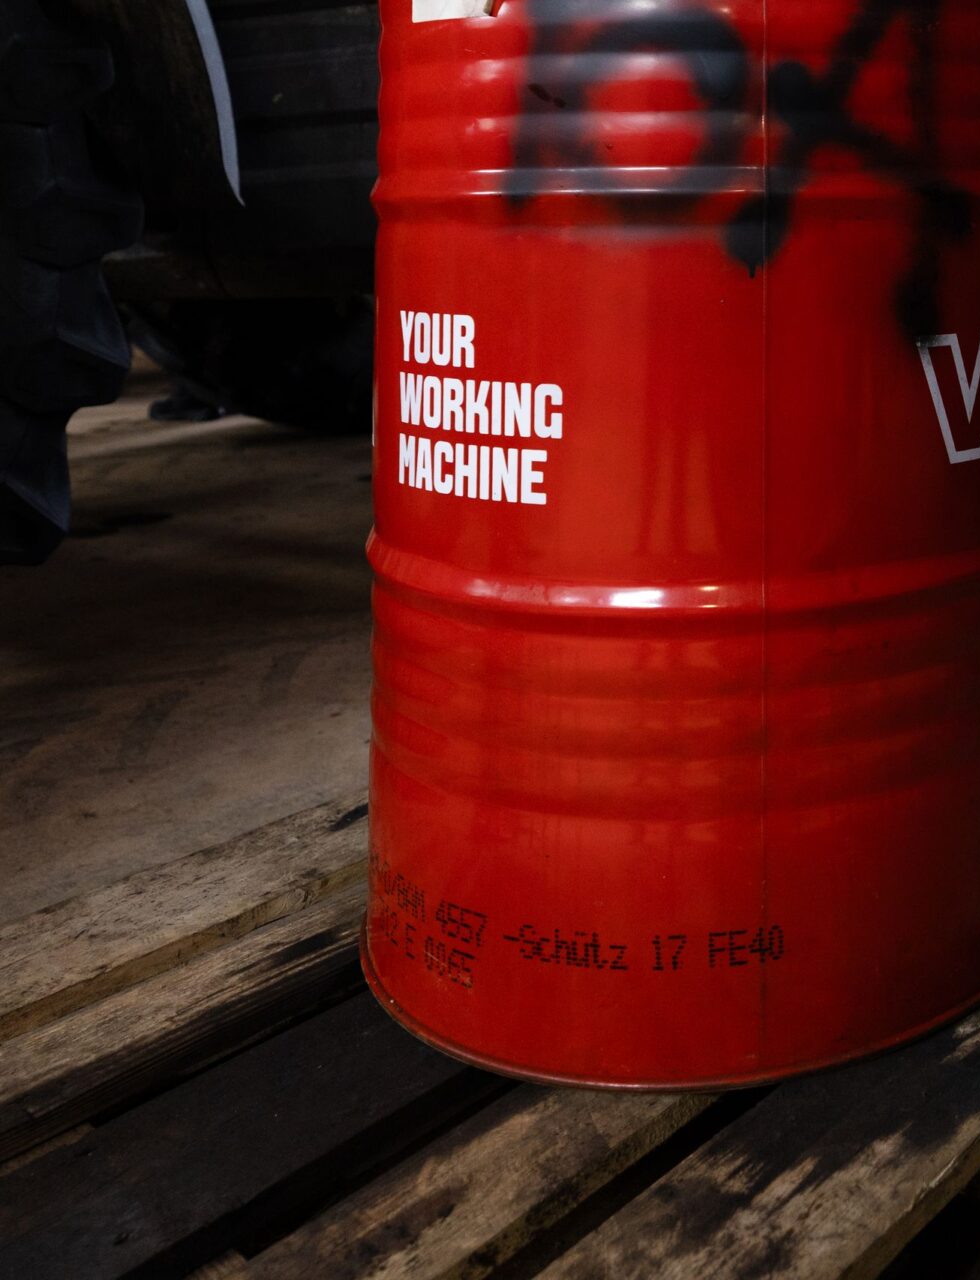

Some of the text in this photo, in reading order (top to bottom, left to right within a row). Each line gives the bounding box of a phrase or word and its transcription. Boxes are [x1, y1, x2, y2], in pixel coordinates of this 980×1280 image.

[400, 310, 475, 368] YOUR
[400, 371, 563, 439] WORKING
[399, 433, 547, 505] MACHINE
[652, 934, 688, 971] 17
[708, 925, 784, 968] FE40
